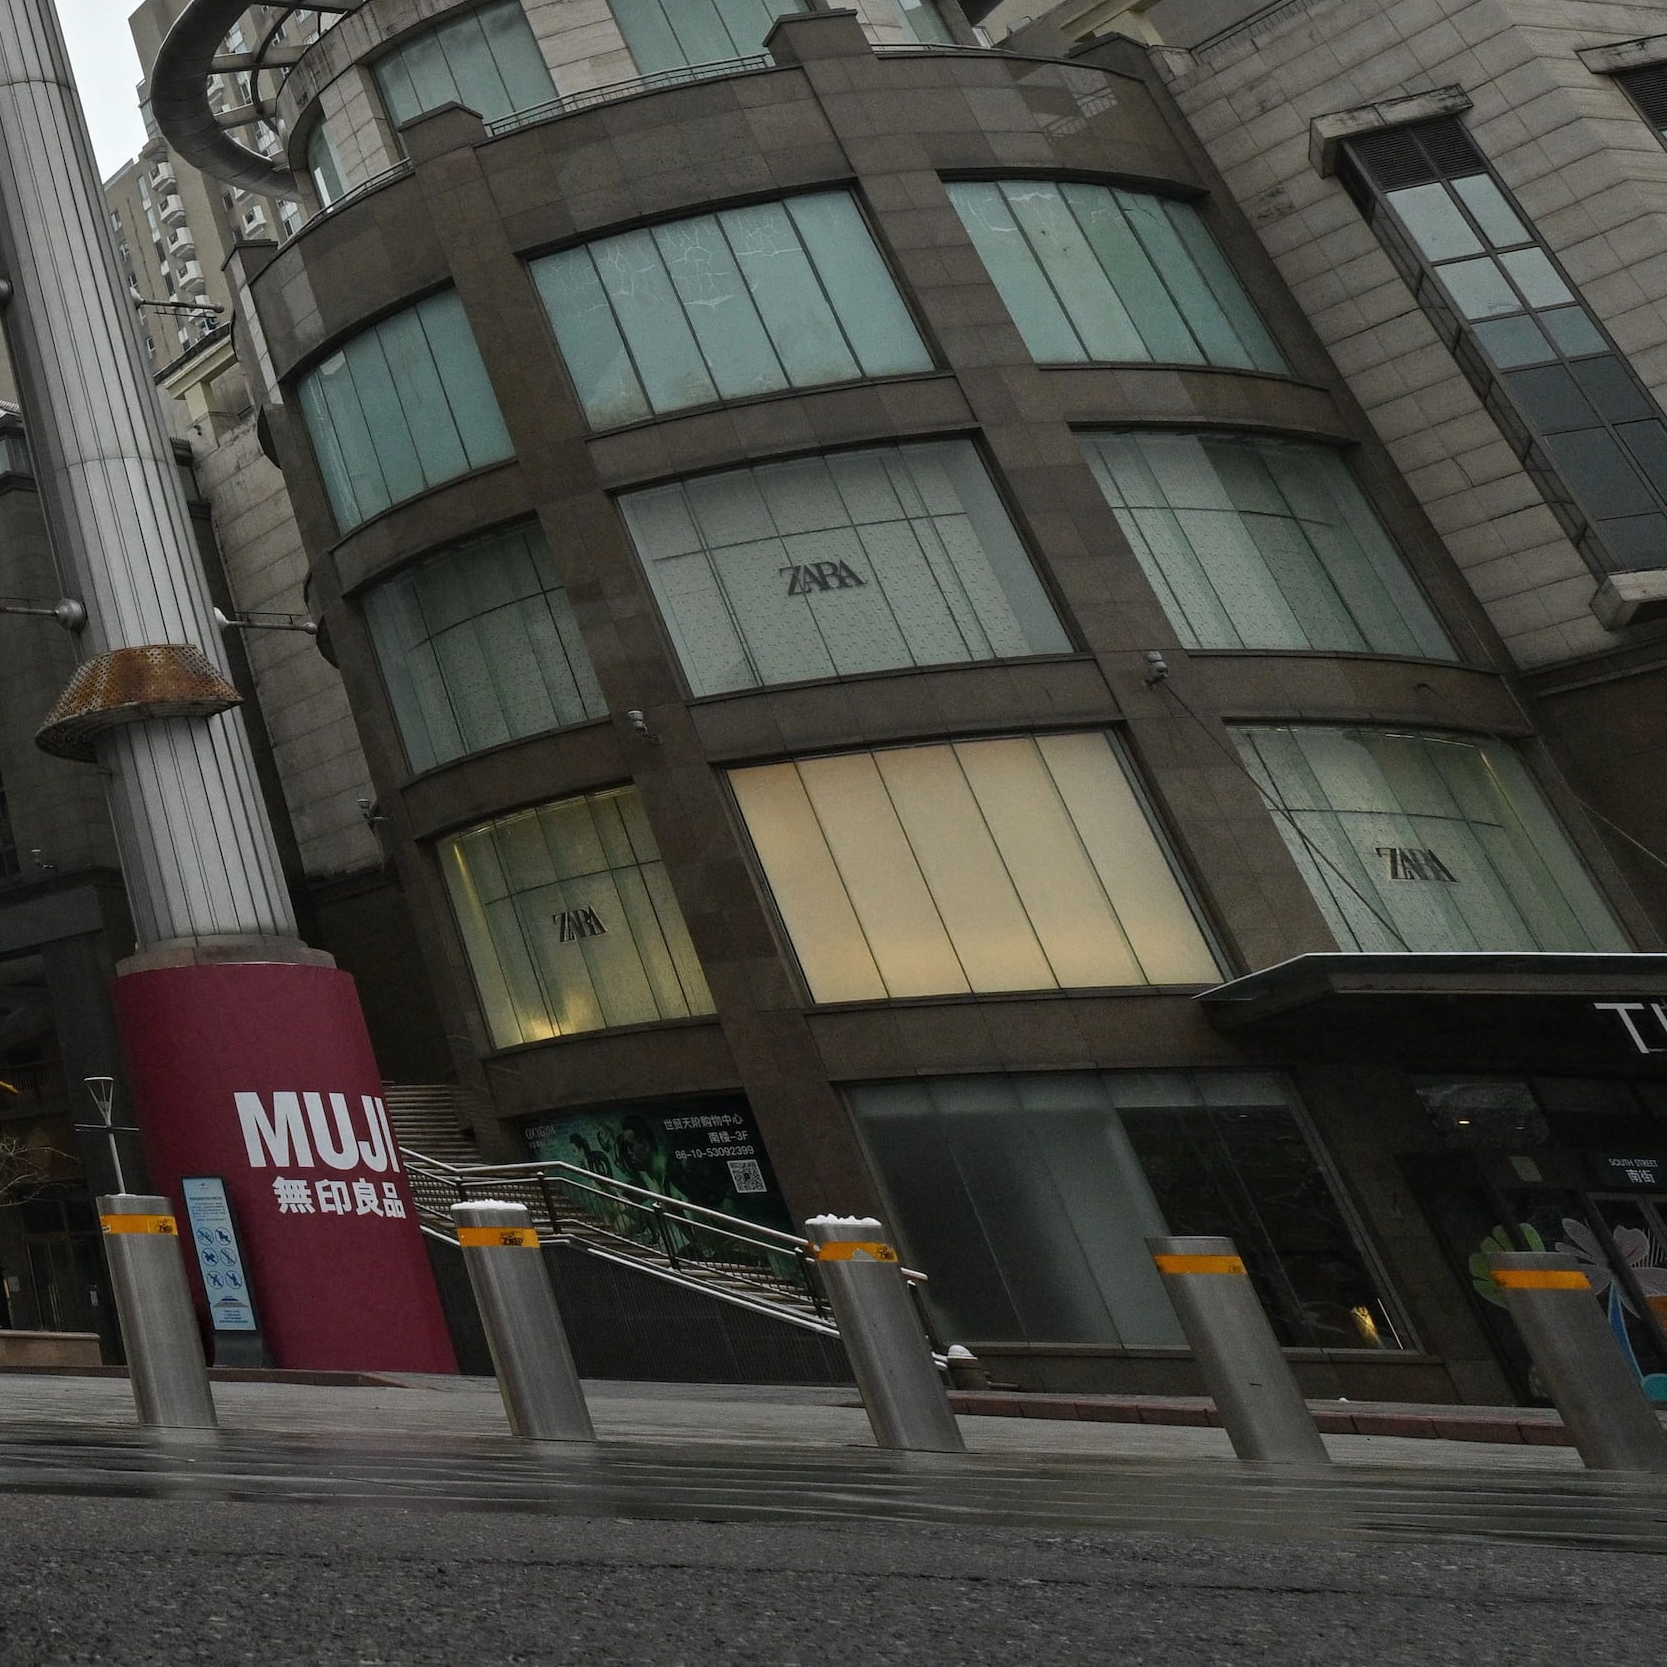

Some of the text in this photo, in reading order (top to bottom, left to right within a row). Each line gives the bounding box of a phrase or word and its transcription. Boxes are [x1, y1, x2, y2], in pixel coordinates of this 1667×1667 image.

[779, 557, 867, 597] ZARA
[1376, 846, 1459, 883] ZARA
[552, 905, 607, 943] ZARA
[233, 1090, 399, 1174] MUJI
[663, 1113, 744, 1131] 世贸天阶购物中心
[675, 1145, 755, 1160] 86-10-53092399
[1608, 1158, 1659, 1168] SOUTH STREET
[1625, 1169, 1656, 1184] 南街
[273, 1176, 407, 1220] 無印良品
